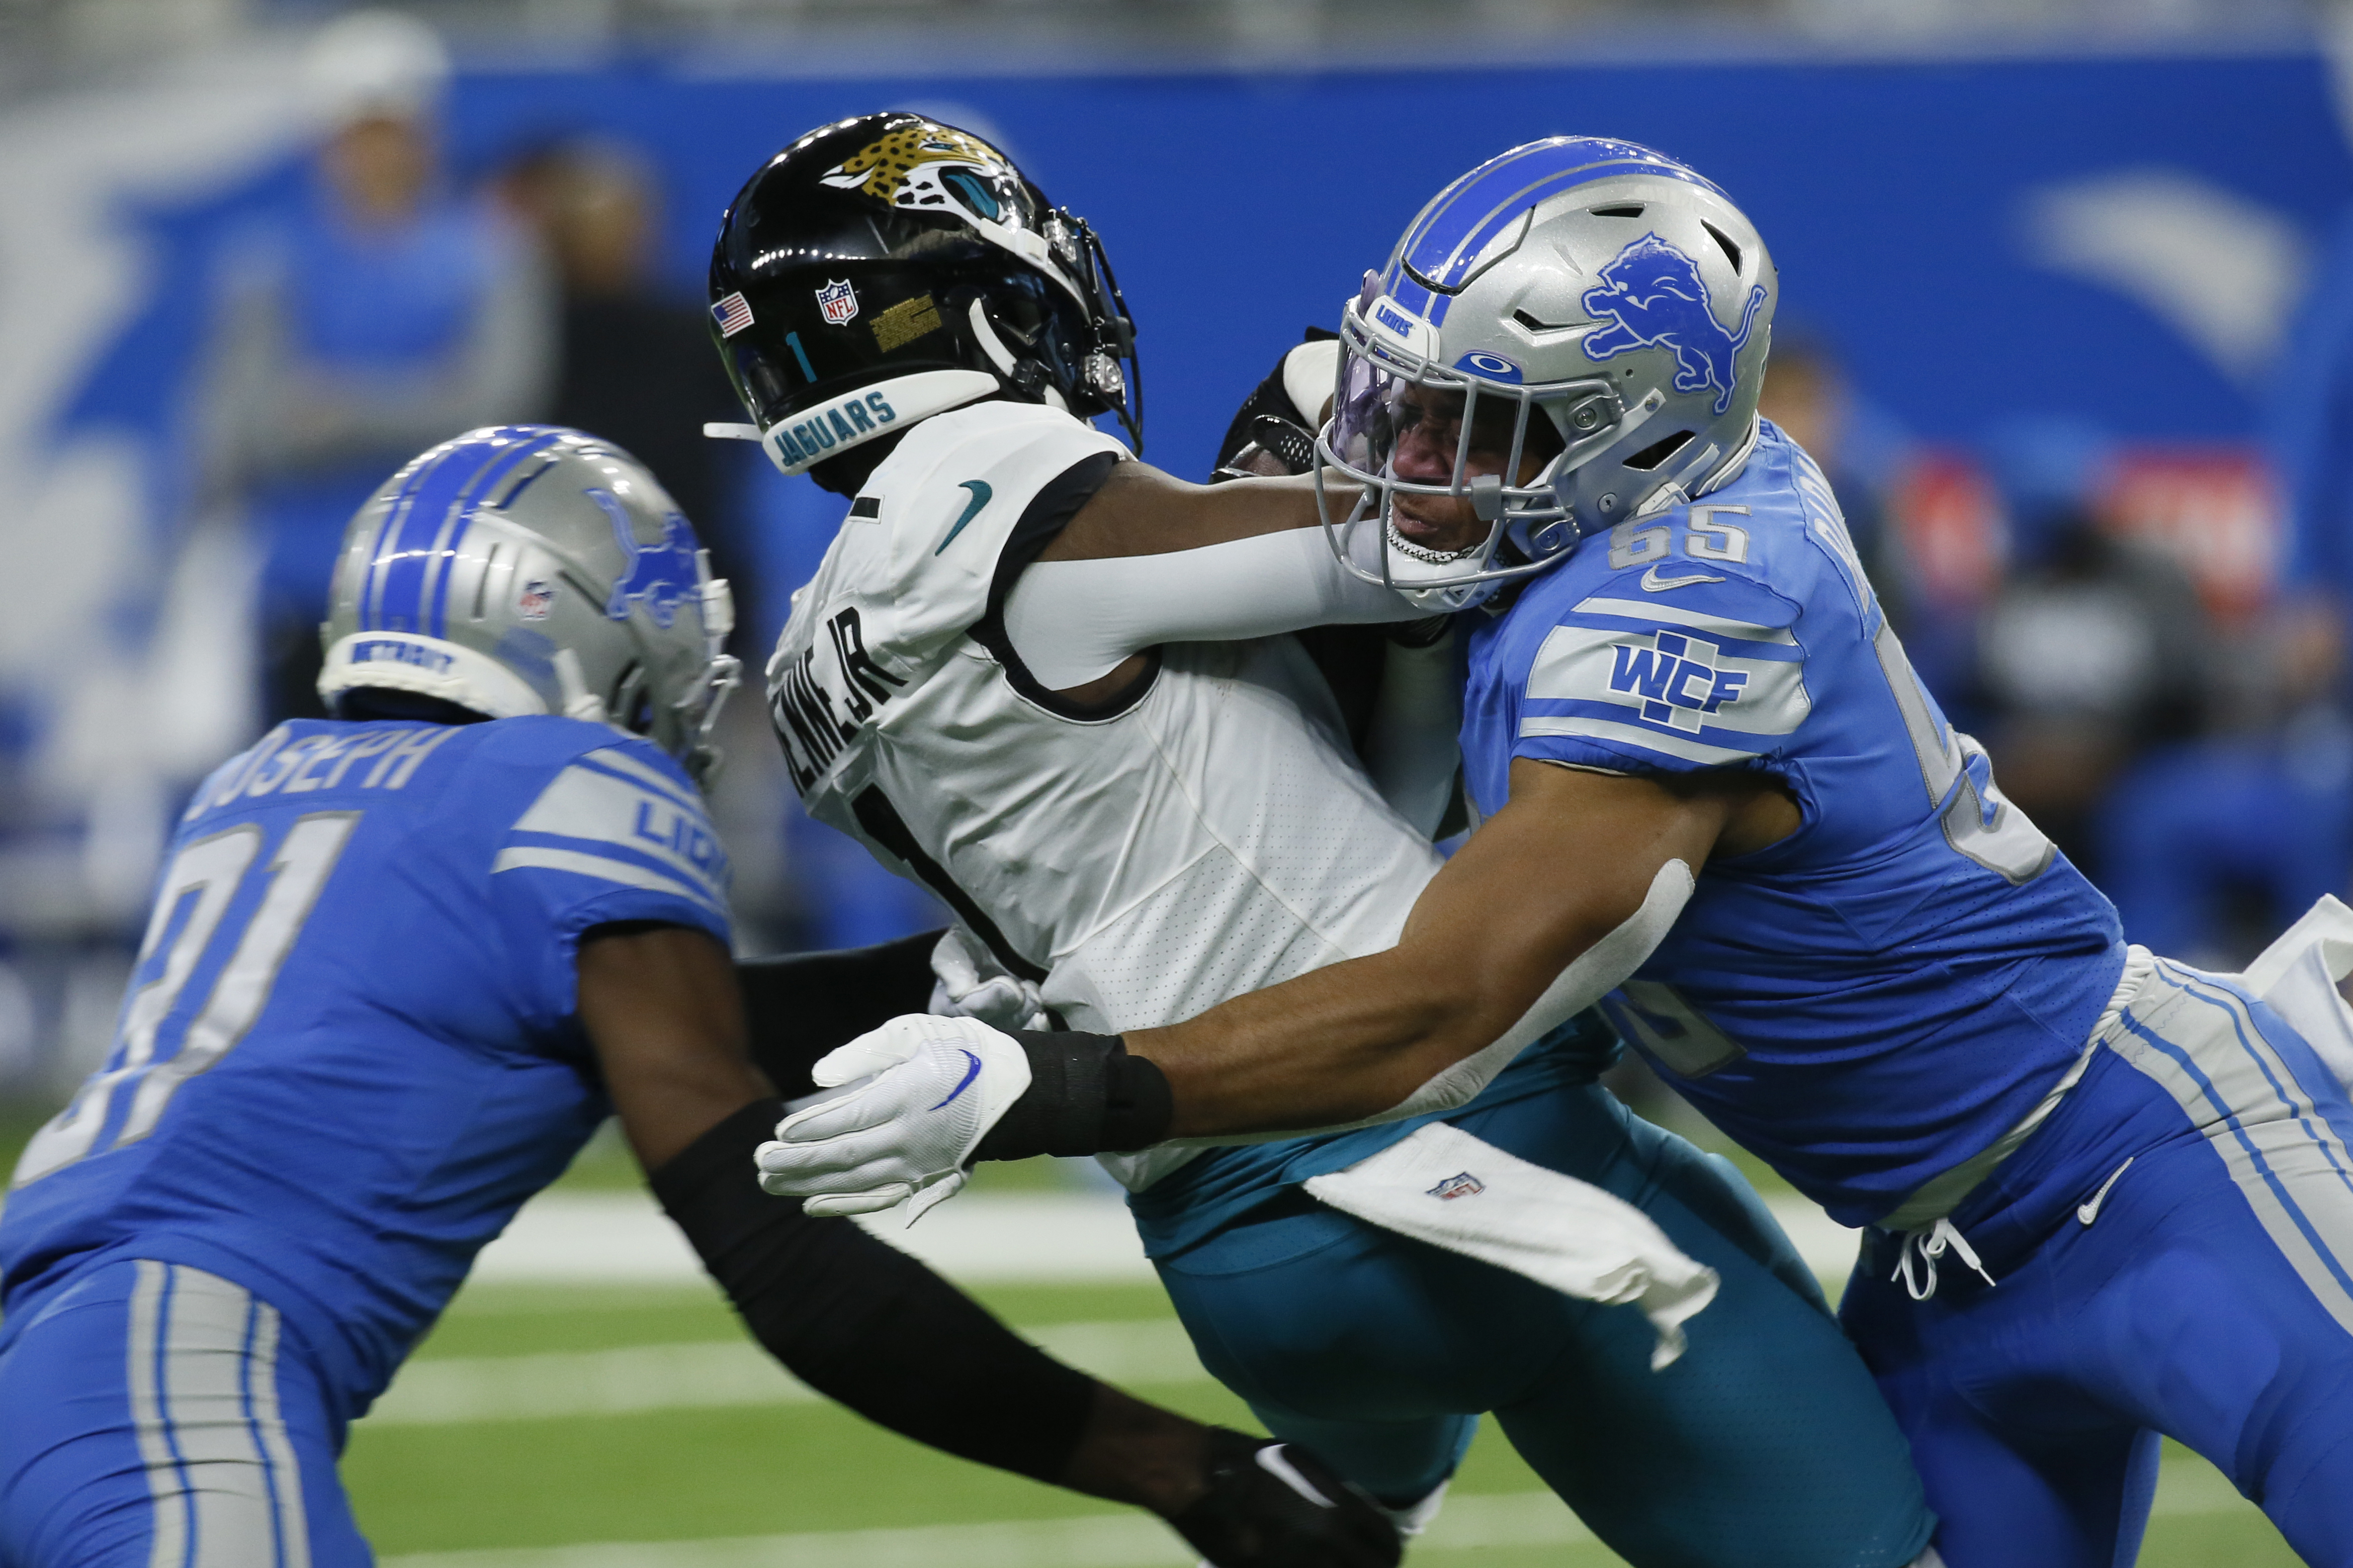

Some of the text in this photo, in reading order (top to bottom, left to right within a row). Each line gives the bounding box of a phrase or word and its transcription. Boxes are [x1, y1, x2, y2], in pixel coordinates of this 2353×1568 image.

[826, 298, 854, 318] NFL
[1375, 304, 1414, 337] LIONS
[785, 331, 818, 383] 1
[774, 391, 896, 467] JAGUARS
[1607, 644, 1750, 716] WCF
